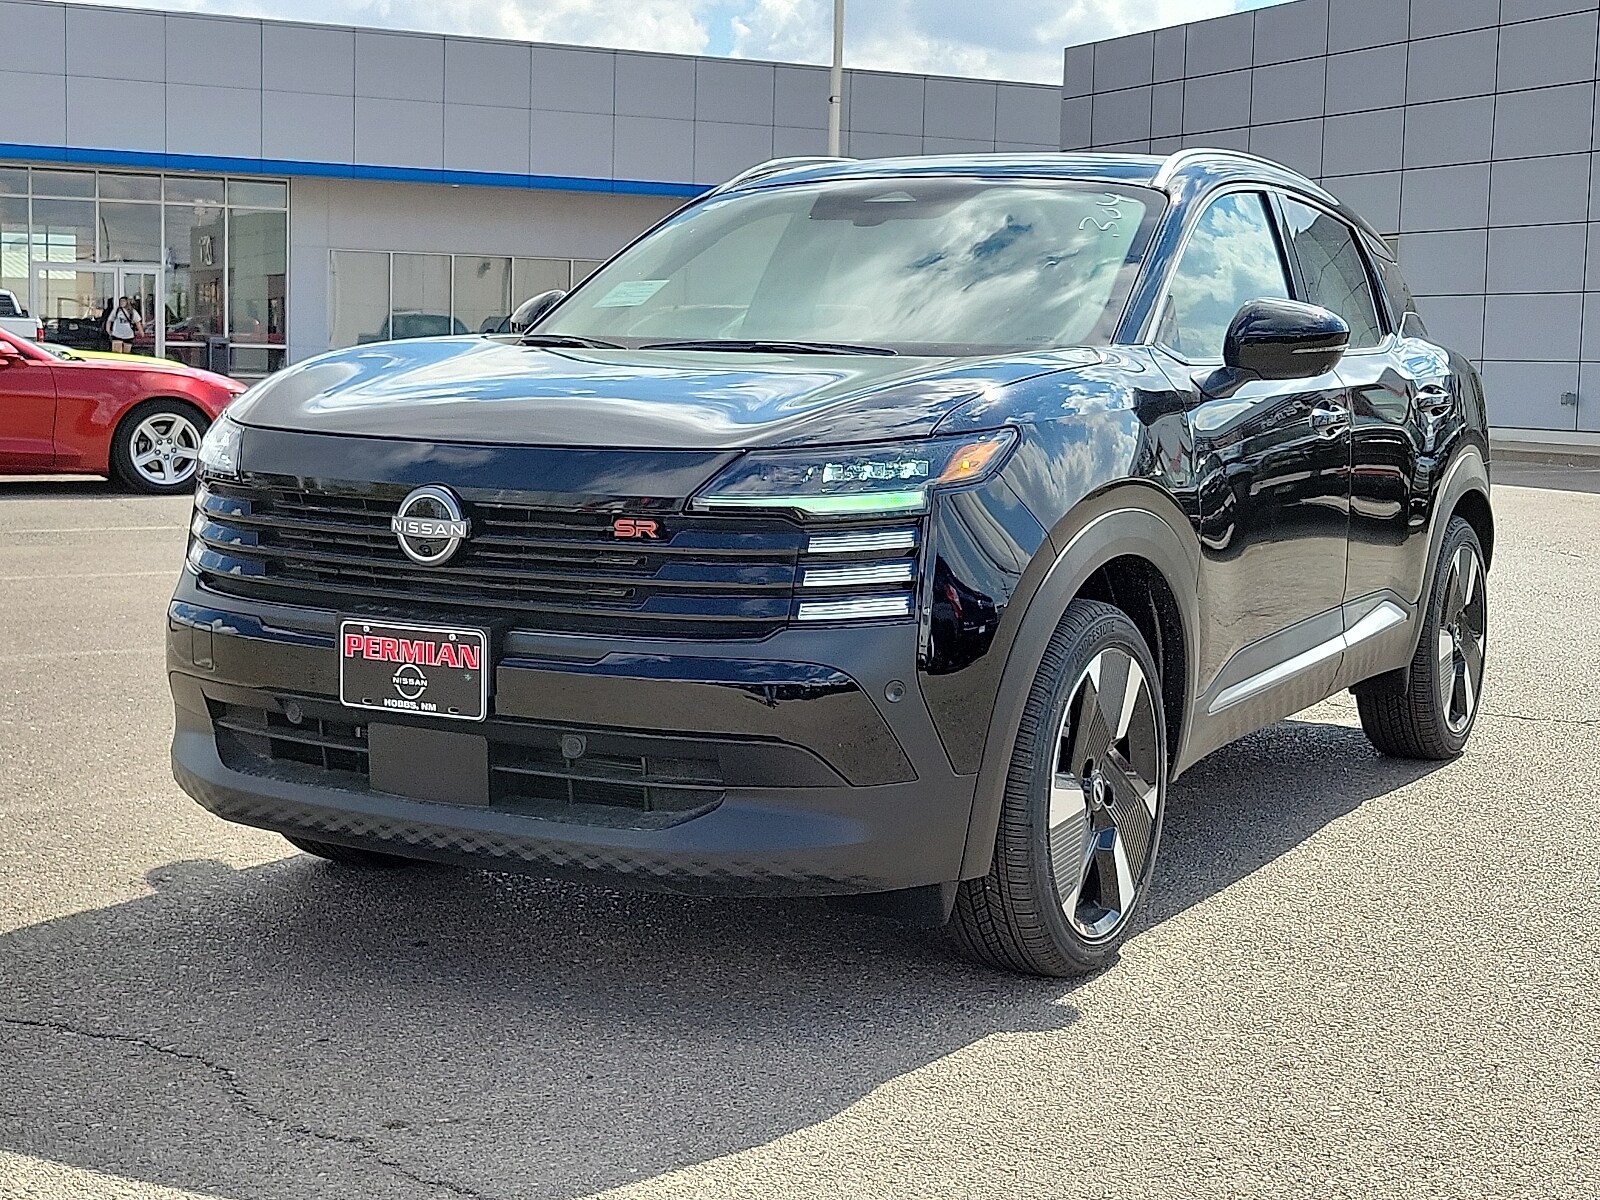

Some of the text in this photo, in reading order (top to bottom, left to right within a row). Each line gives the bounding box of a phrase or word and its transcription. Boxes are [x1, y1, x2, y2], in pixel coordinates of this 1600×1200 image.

[392, 518, 466, 538] NISSAN
[613, 518, 660, 539] SR
[345, 633, 480, 670] PERMIAN
[392, 676, 428, 687] NISSAN
[384, 698, 437, 712] HOBBS, NM
